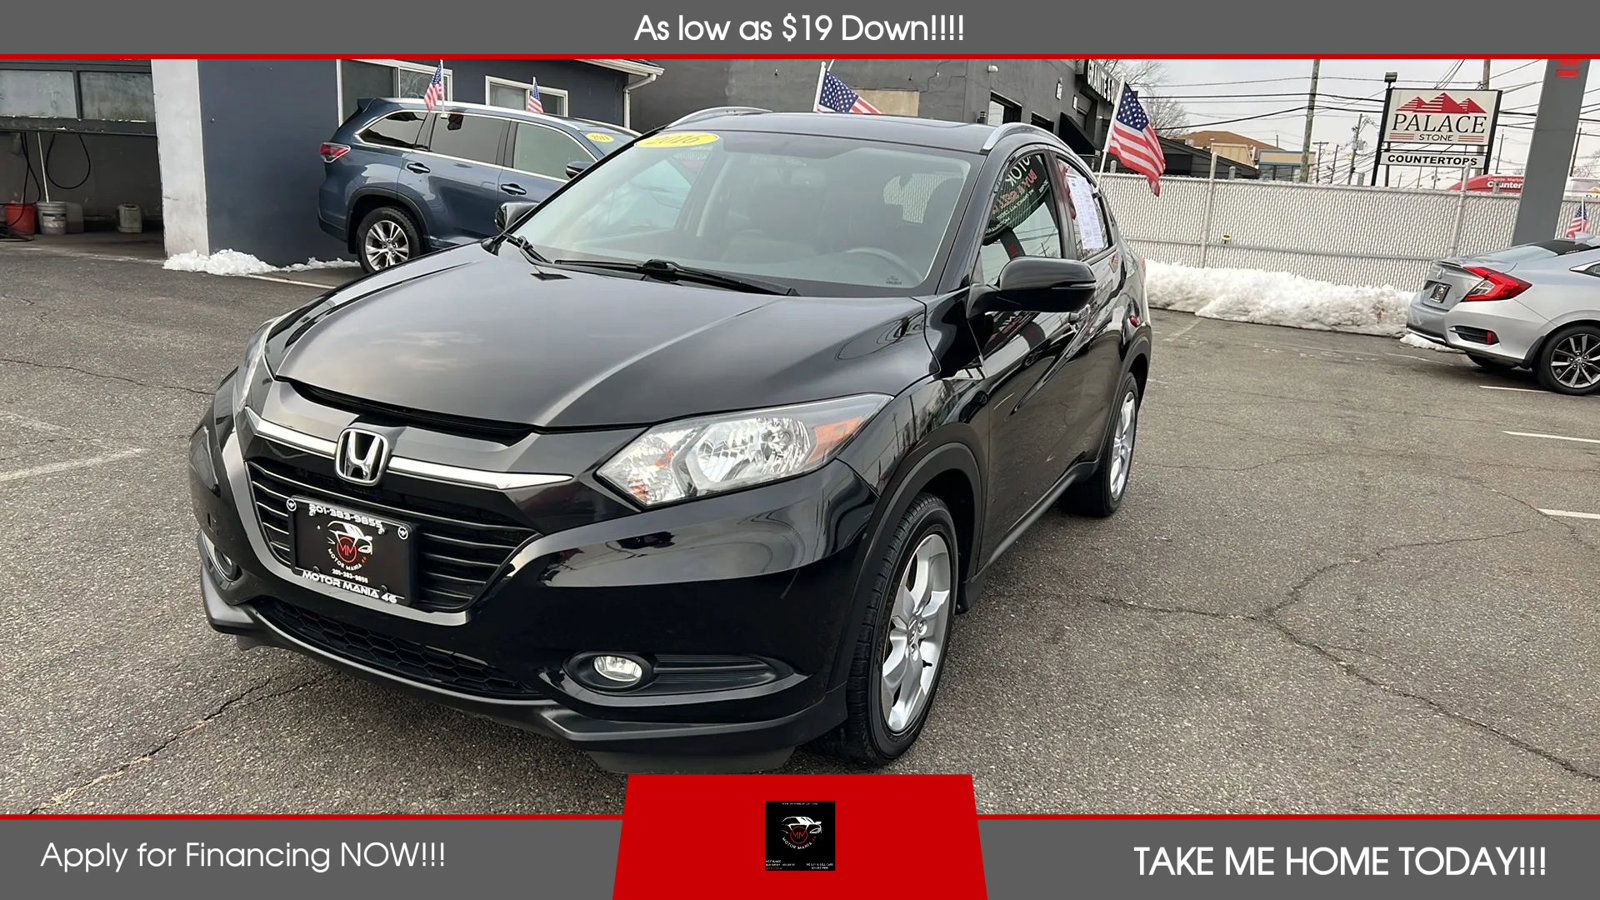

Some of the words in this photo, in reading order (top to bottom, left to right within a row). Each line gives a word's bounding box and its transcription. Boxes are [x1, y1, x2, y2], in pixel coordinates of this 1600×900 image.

[1392, 113, 1487, 134] PALACE
[1419, 133, 1454, 142] STONE
[1388, 154, 1478, 166] COUNTERTOPS
[328, 547, 345, 568] MOTOR
[302, 570, 341, 588] MOTOR
[342, 581, 380, 599] MANIA
[381, 592, 398, 604] 46
